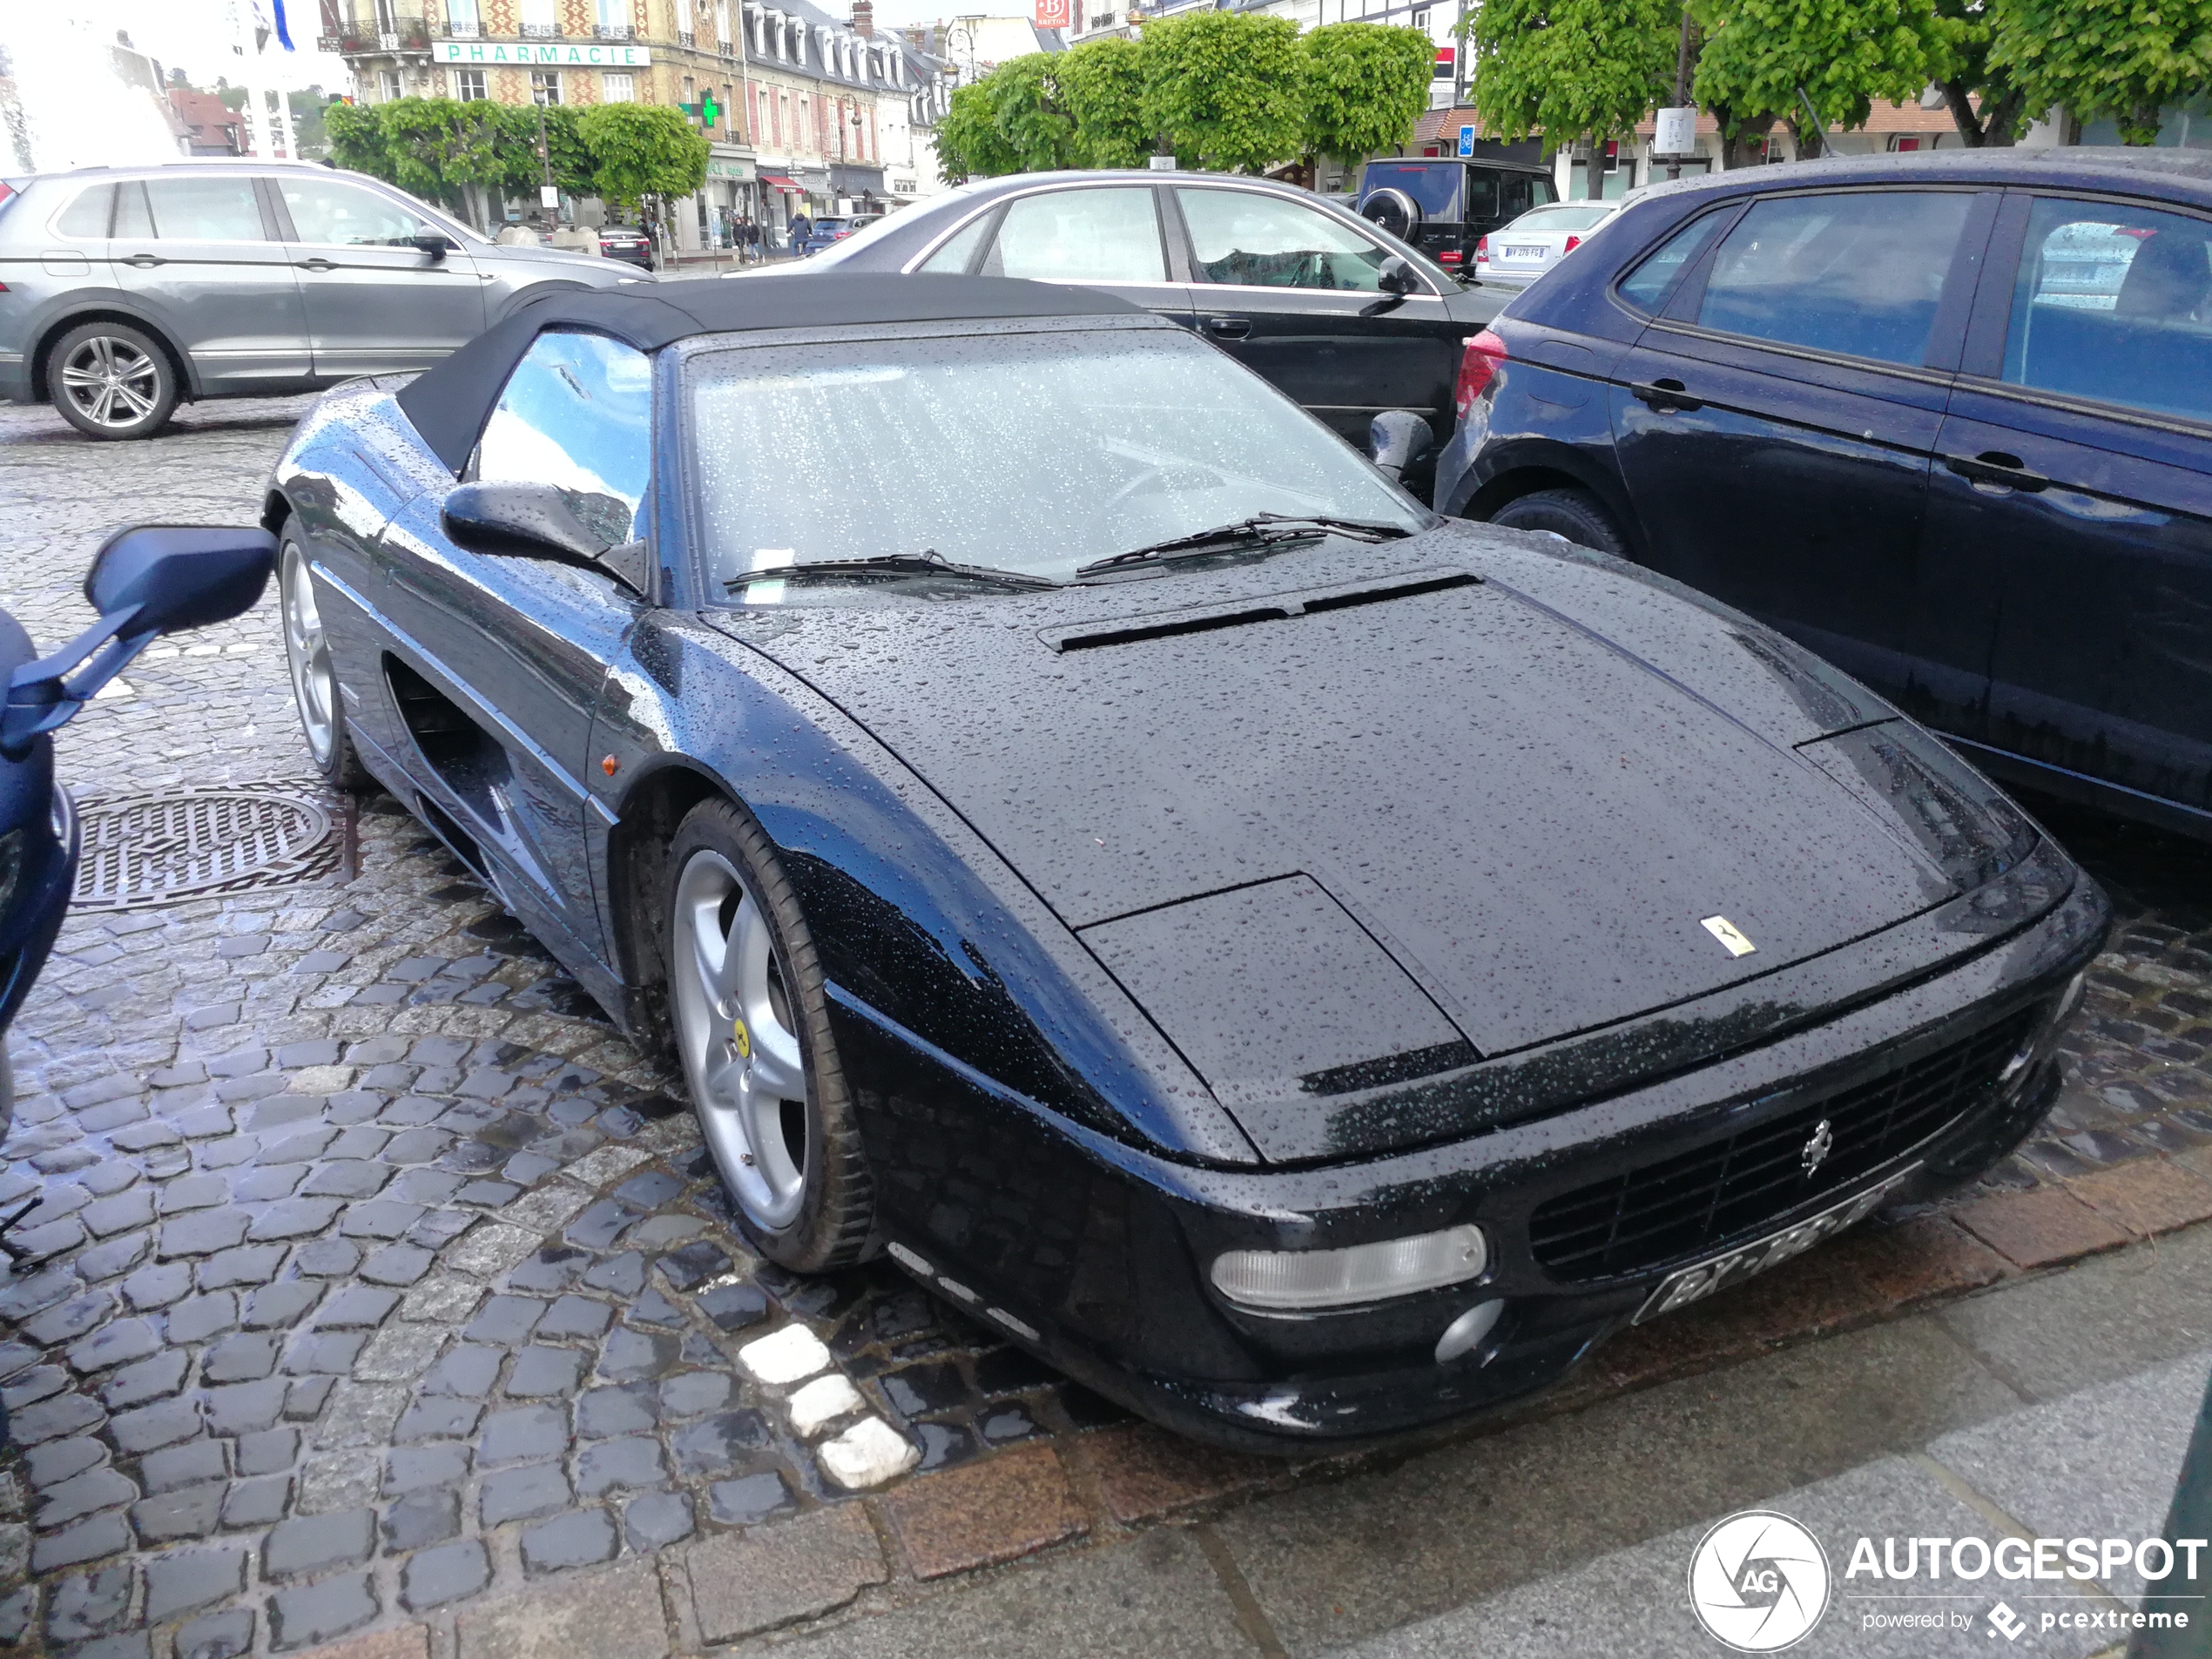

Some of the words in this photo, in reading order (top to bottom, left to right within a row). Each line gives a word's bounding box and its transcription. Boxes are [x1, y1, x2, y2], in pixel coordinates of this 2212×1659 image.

[448, 44, 636, 64] PHARMACIE
[1509, 247, 1516, 256] BV
[1518, 247, 1529, 257] 276
[1530, 247, 1539, 257] FG
